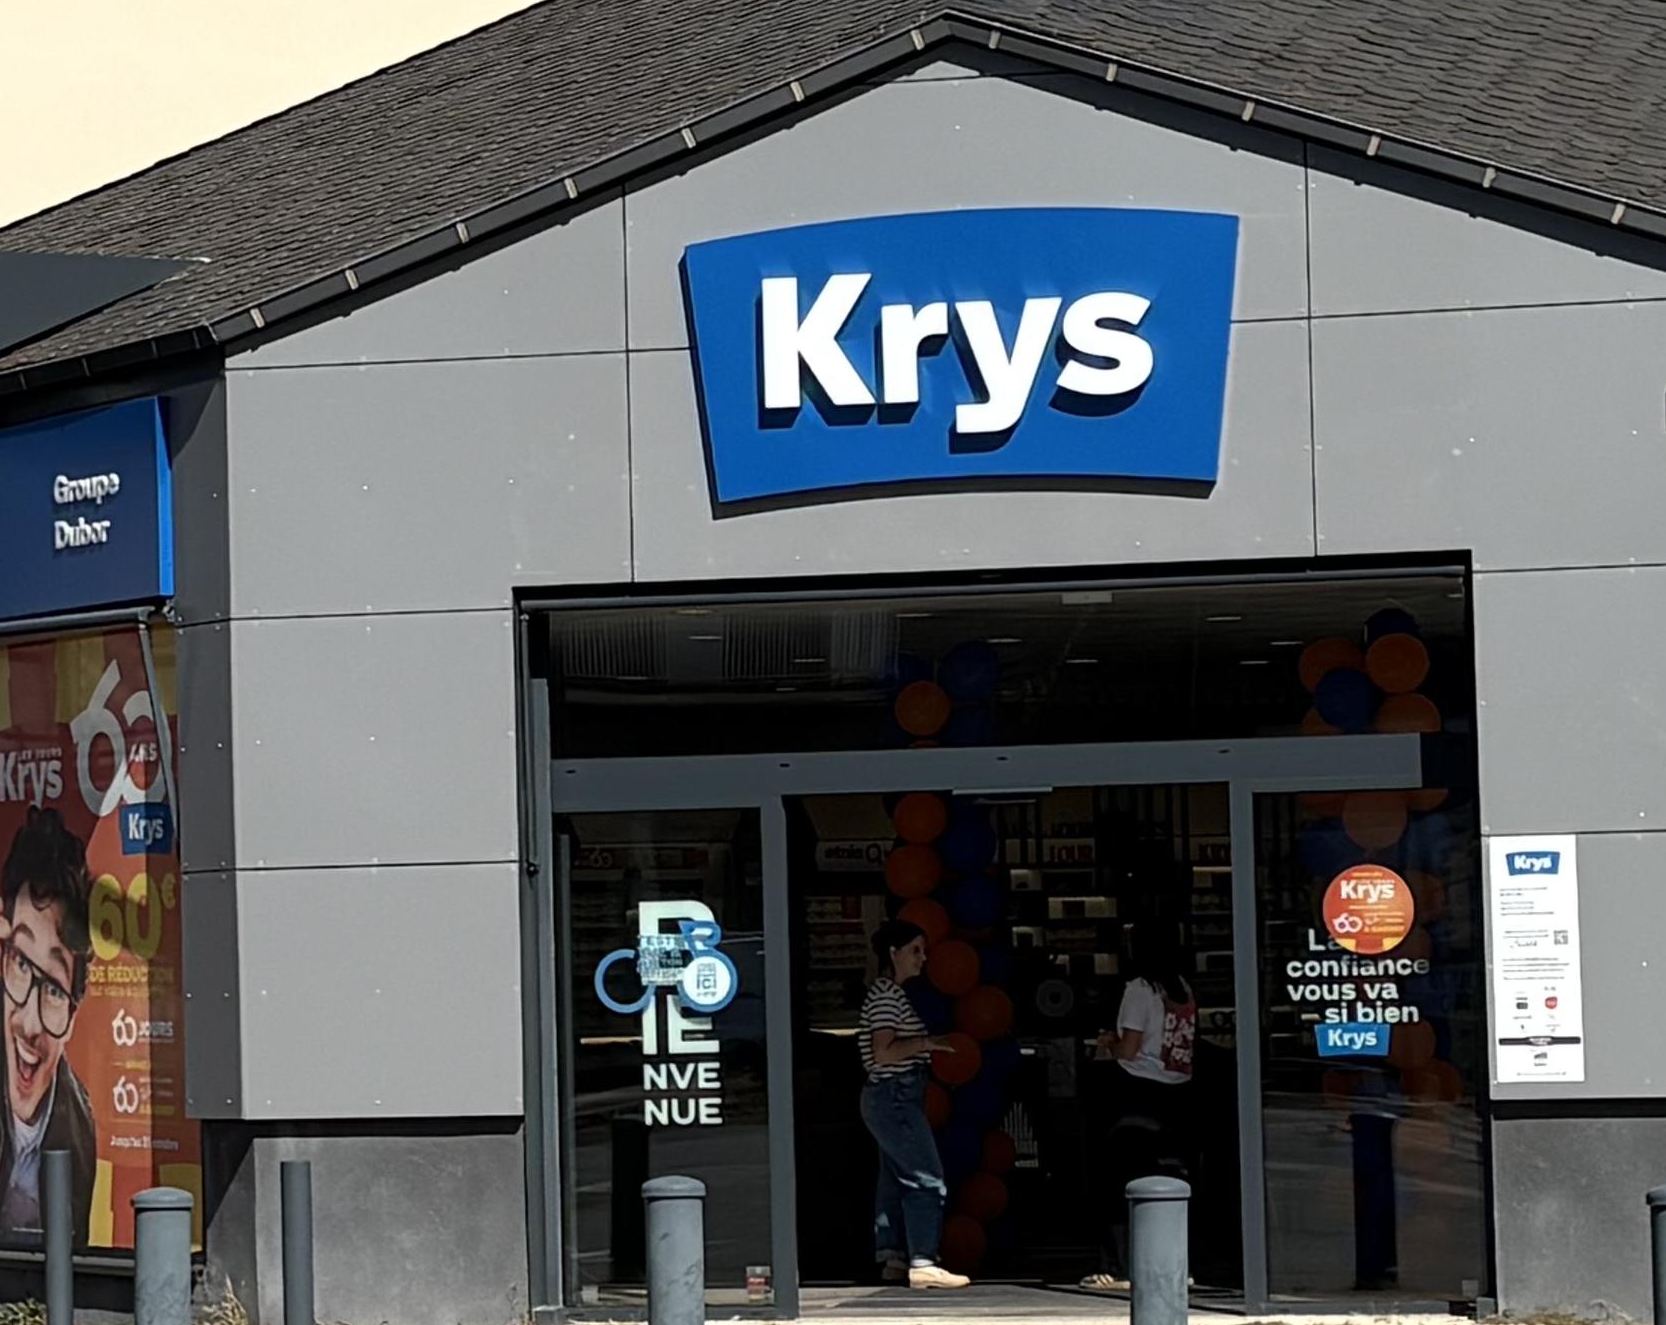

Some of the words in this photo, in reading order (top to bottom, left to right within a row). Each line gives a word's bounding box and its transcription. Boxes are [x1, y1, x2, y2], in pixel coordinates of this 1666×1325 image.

[760, 272, 1155, 435] Krys
[53, 472, 121, 505] Groupe
[128, 812, 164, 845] Krys
[1513, 854, 1553, 872] Krys
[1340, 879, 1395, 904] Krys
[1286, 955, 1430, 978] confiance
[1286, 982, 1357, 1002] vous
[1362, 982, 1399, 1001] va
[1325, 1002, 1348, 1024] si
[1356, 1001, 1419, 1024] bien
[1327, 1028, 1378, 1050] Krys
[642, 1061, 722, 1091] NVE
[643, 1097, 723, 1126] NUE
